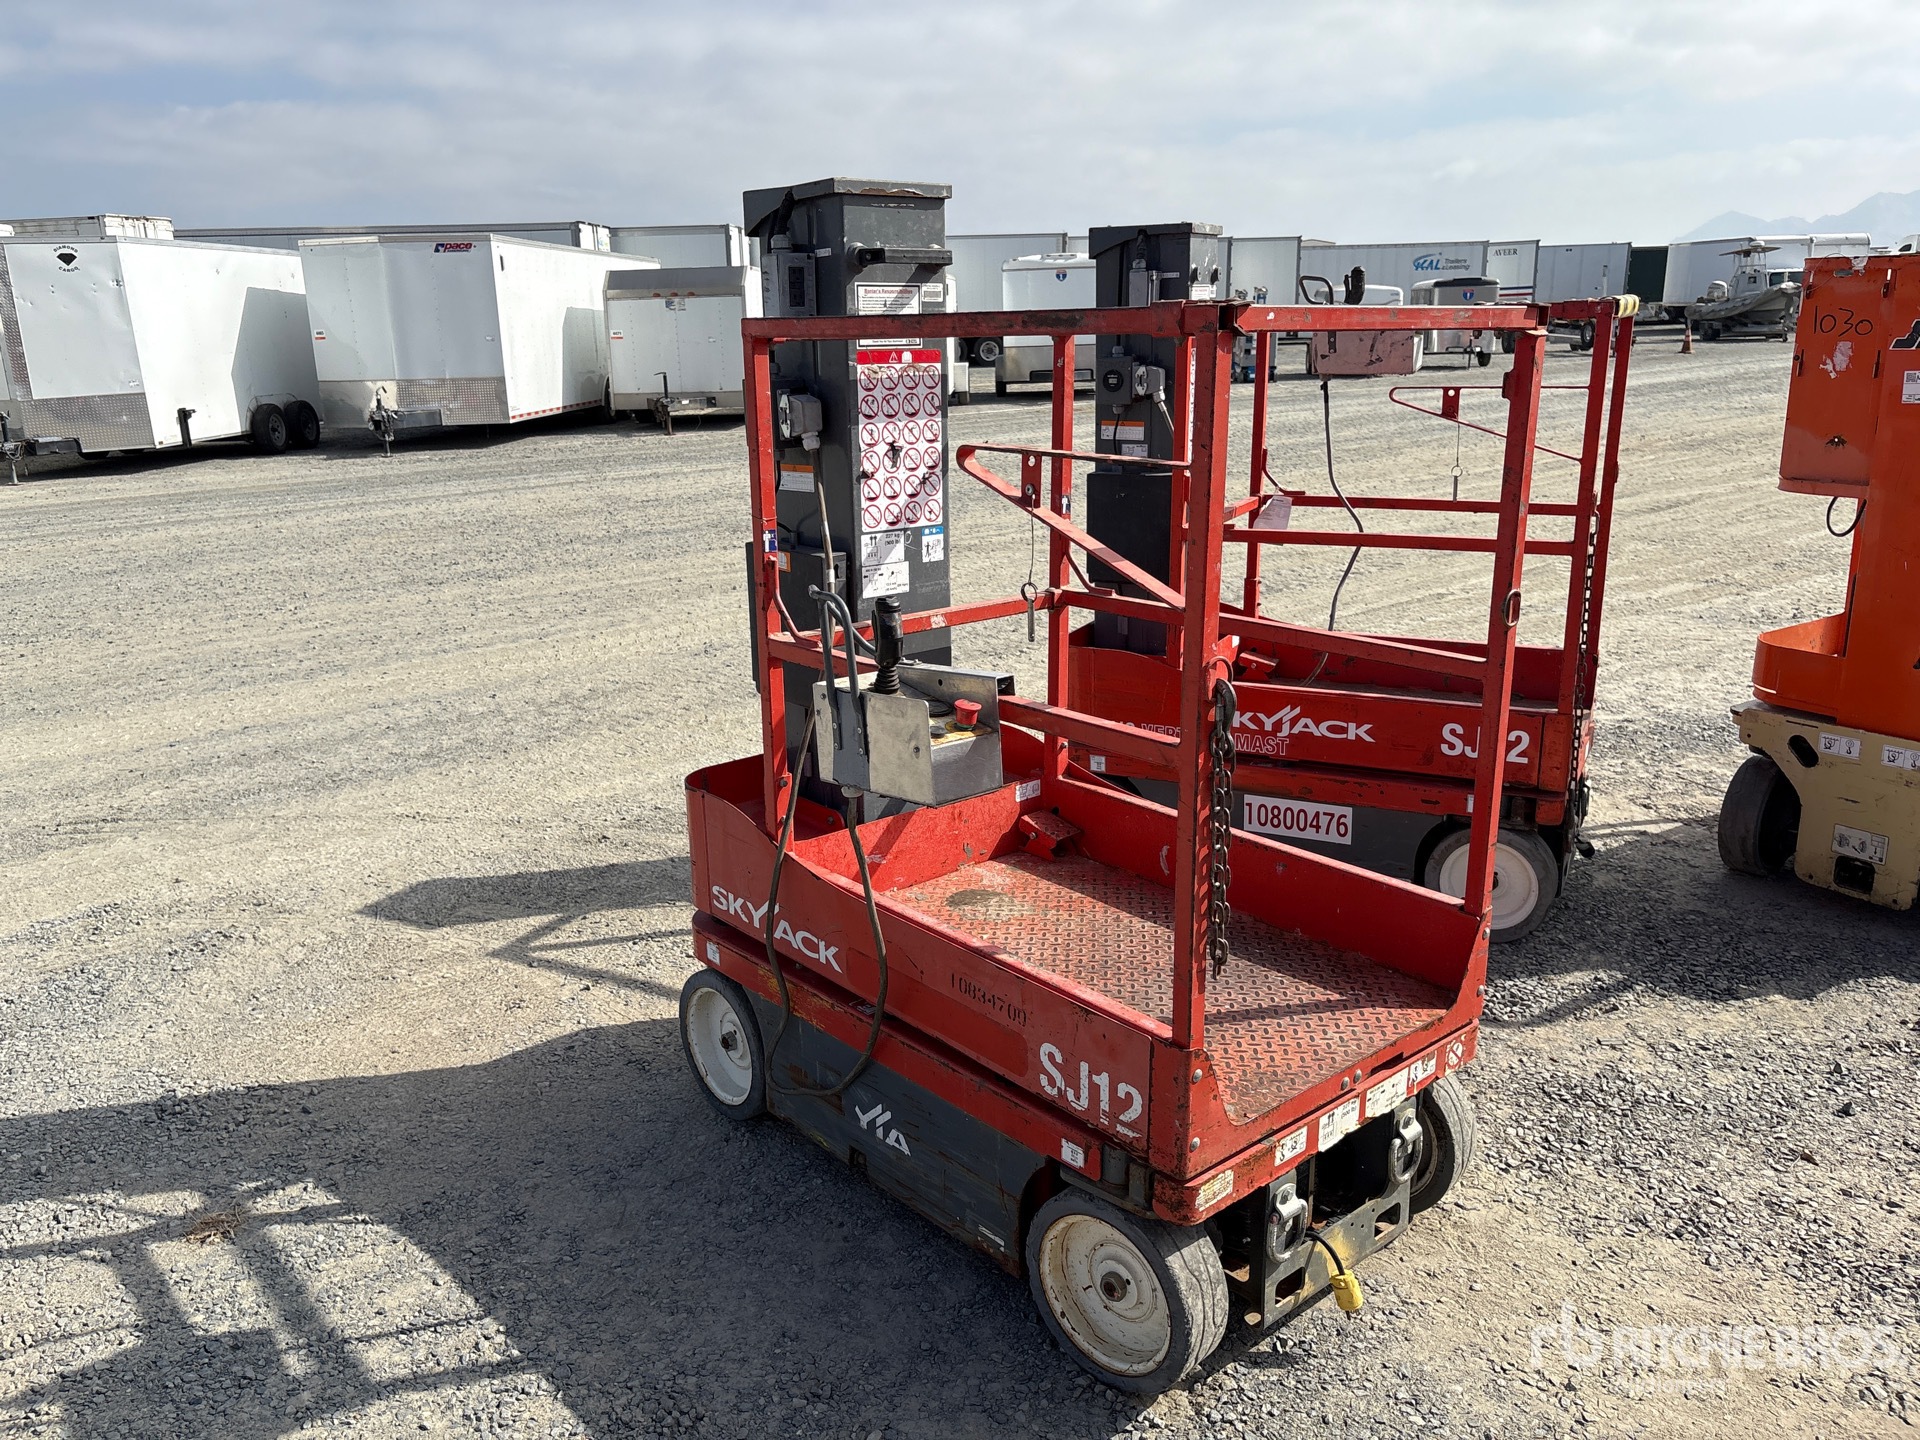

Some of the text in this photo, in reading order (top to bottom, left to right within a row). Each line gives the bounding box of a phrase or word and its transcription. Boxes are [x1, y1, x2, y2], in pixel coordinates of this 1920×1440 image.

[53, 245, 78, 253] DIAMOND
[1493, 248, 1518, 257] AVEER
[1813, 305, 1874, 338] 1030
[1232, 704, 1376, 743] KYJACK
[1234, 733, 1290, 756] MAST
[1440, 722, 1530, 765] SJ2
[1245, 802, 1349, 838] 10800476
[1039, 1042, 1143, 1138] SJ12
